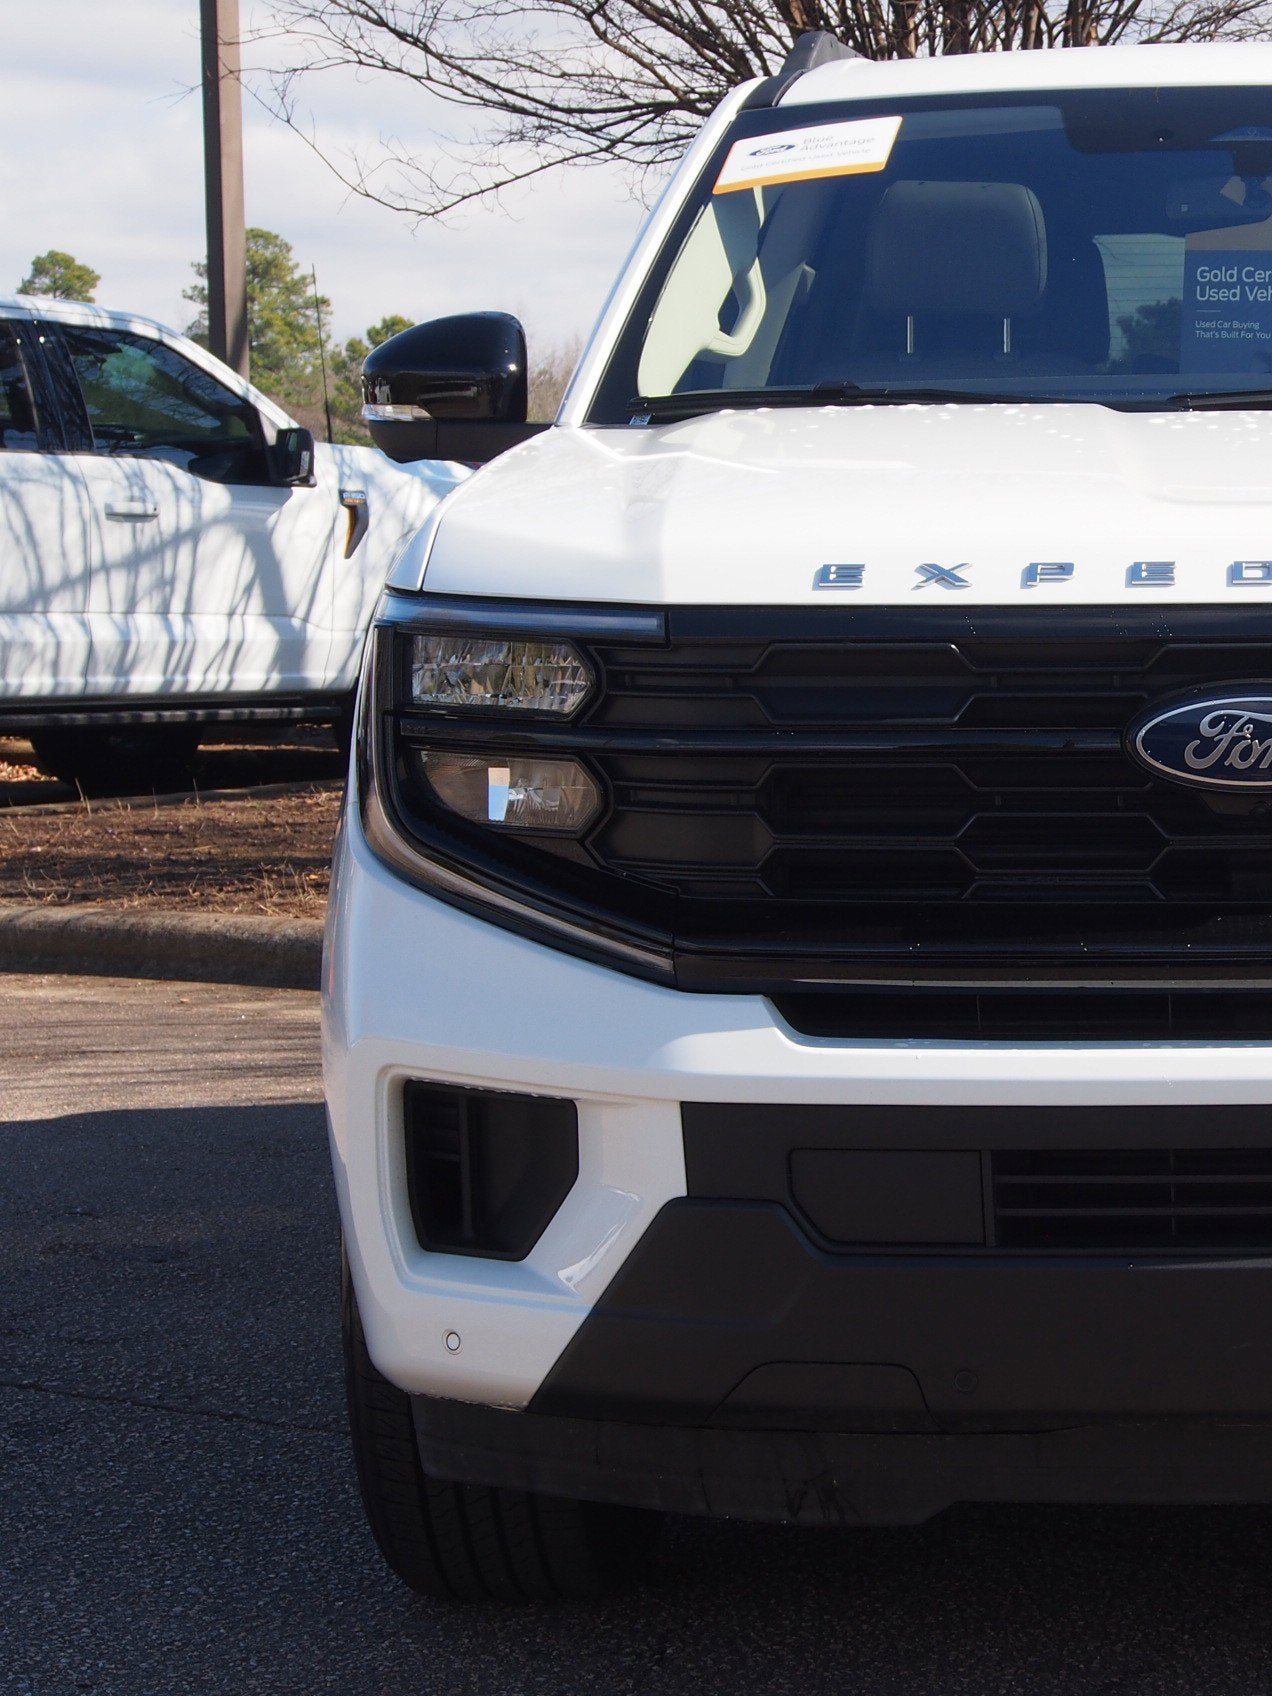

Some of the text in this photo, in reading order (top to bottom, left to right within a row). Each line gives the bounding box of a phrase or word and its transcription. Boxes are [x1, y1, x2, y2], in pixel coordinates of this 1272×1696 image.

[1196, 266, 1237, 282] Gold
[1196, 286, 1240, 301] Used
[1233, 321, 1260, 330] Buying
[1195, 331, 1271, 339] That's Built For You
